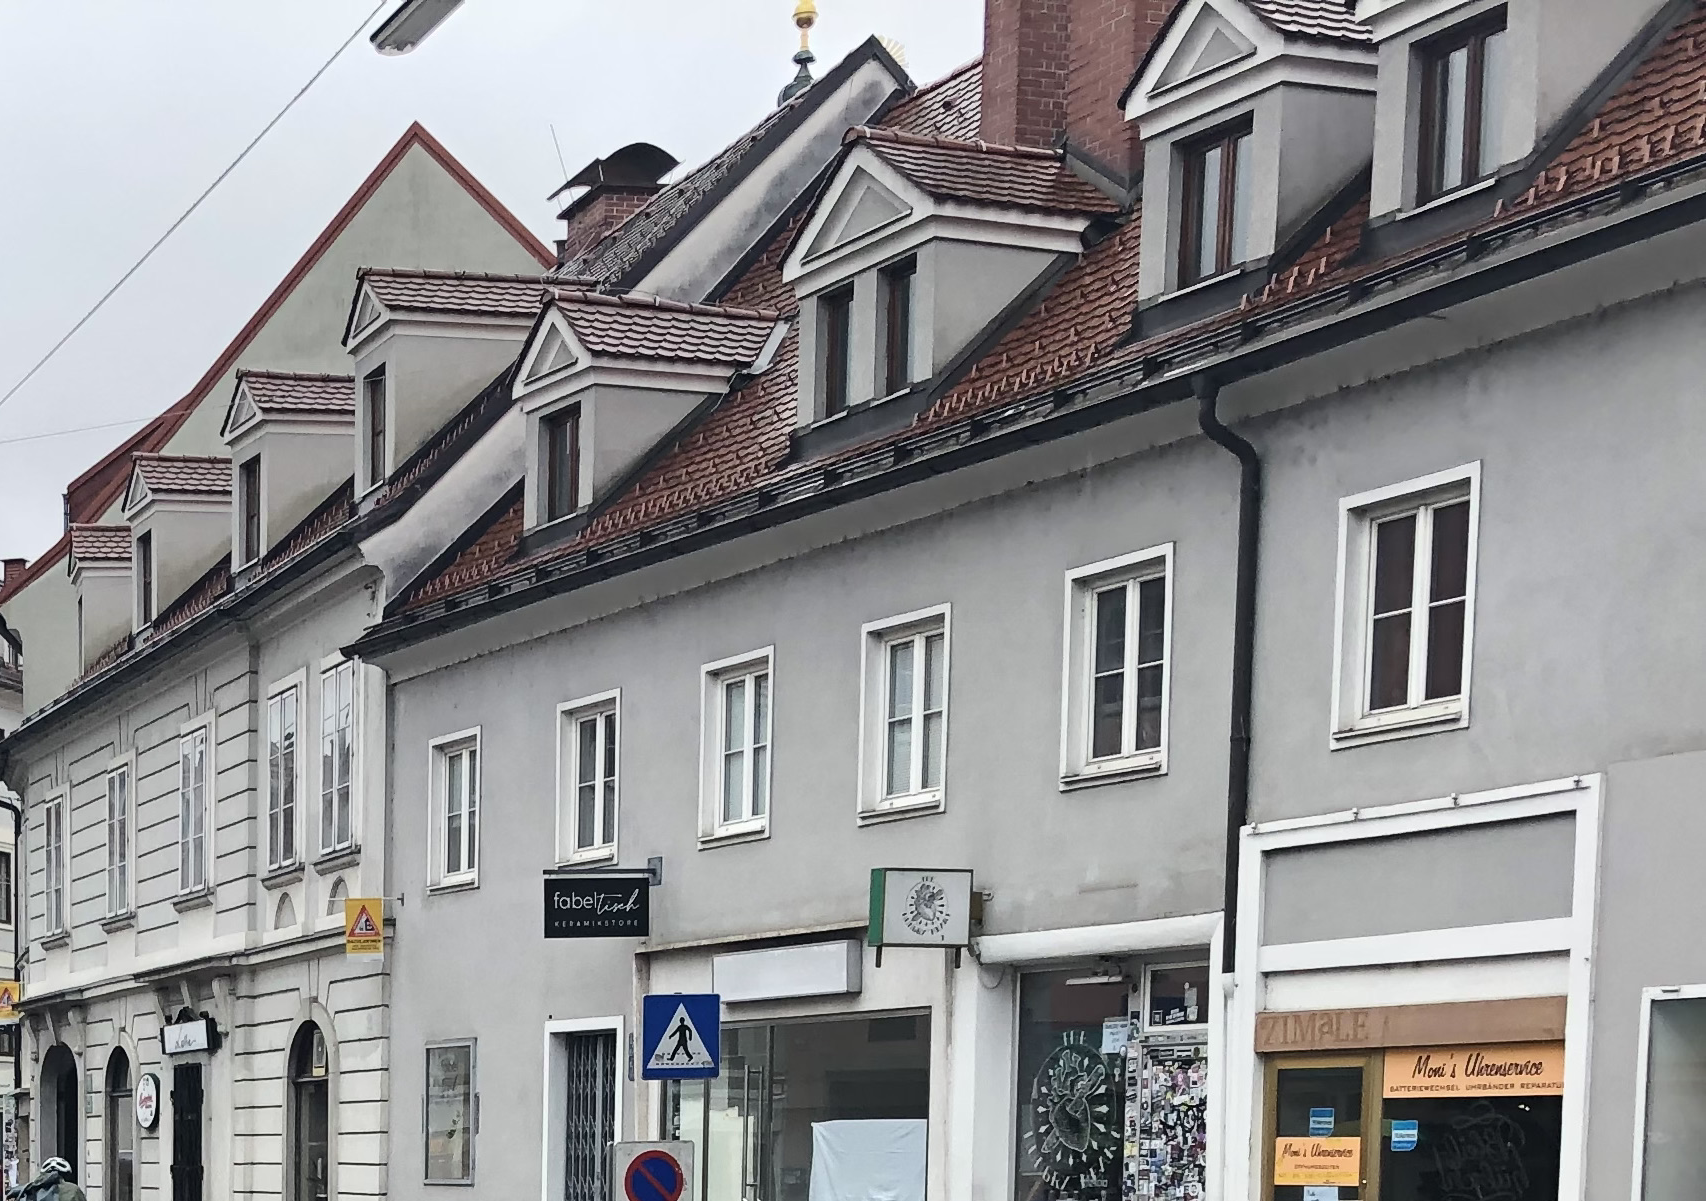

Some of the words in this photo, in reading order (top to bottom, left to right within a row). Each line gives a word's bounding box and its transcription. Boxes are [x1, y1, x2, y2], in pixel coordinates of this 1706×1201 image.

[554, 920, 638, 928] KERAMIKSTORE
[1464, 1053, 1543, 1078] Uhrenservice
[1390, 1085, 1460, 1093] BATTERIEWECHSEL
[1465, 1082, 1515, 1091] UHRBÄNDER
[1520, 1081, 1564, 1089] REPARATU
